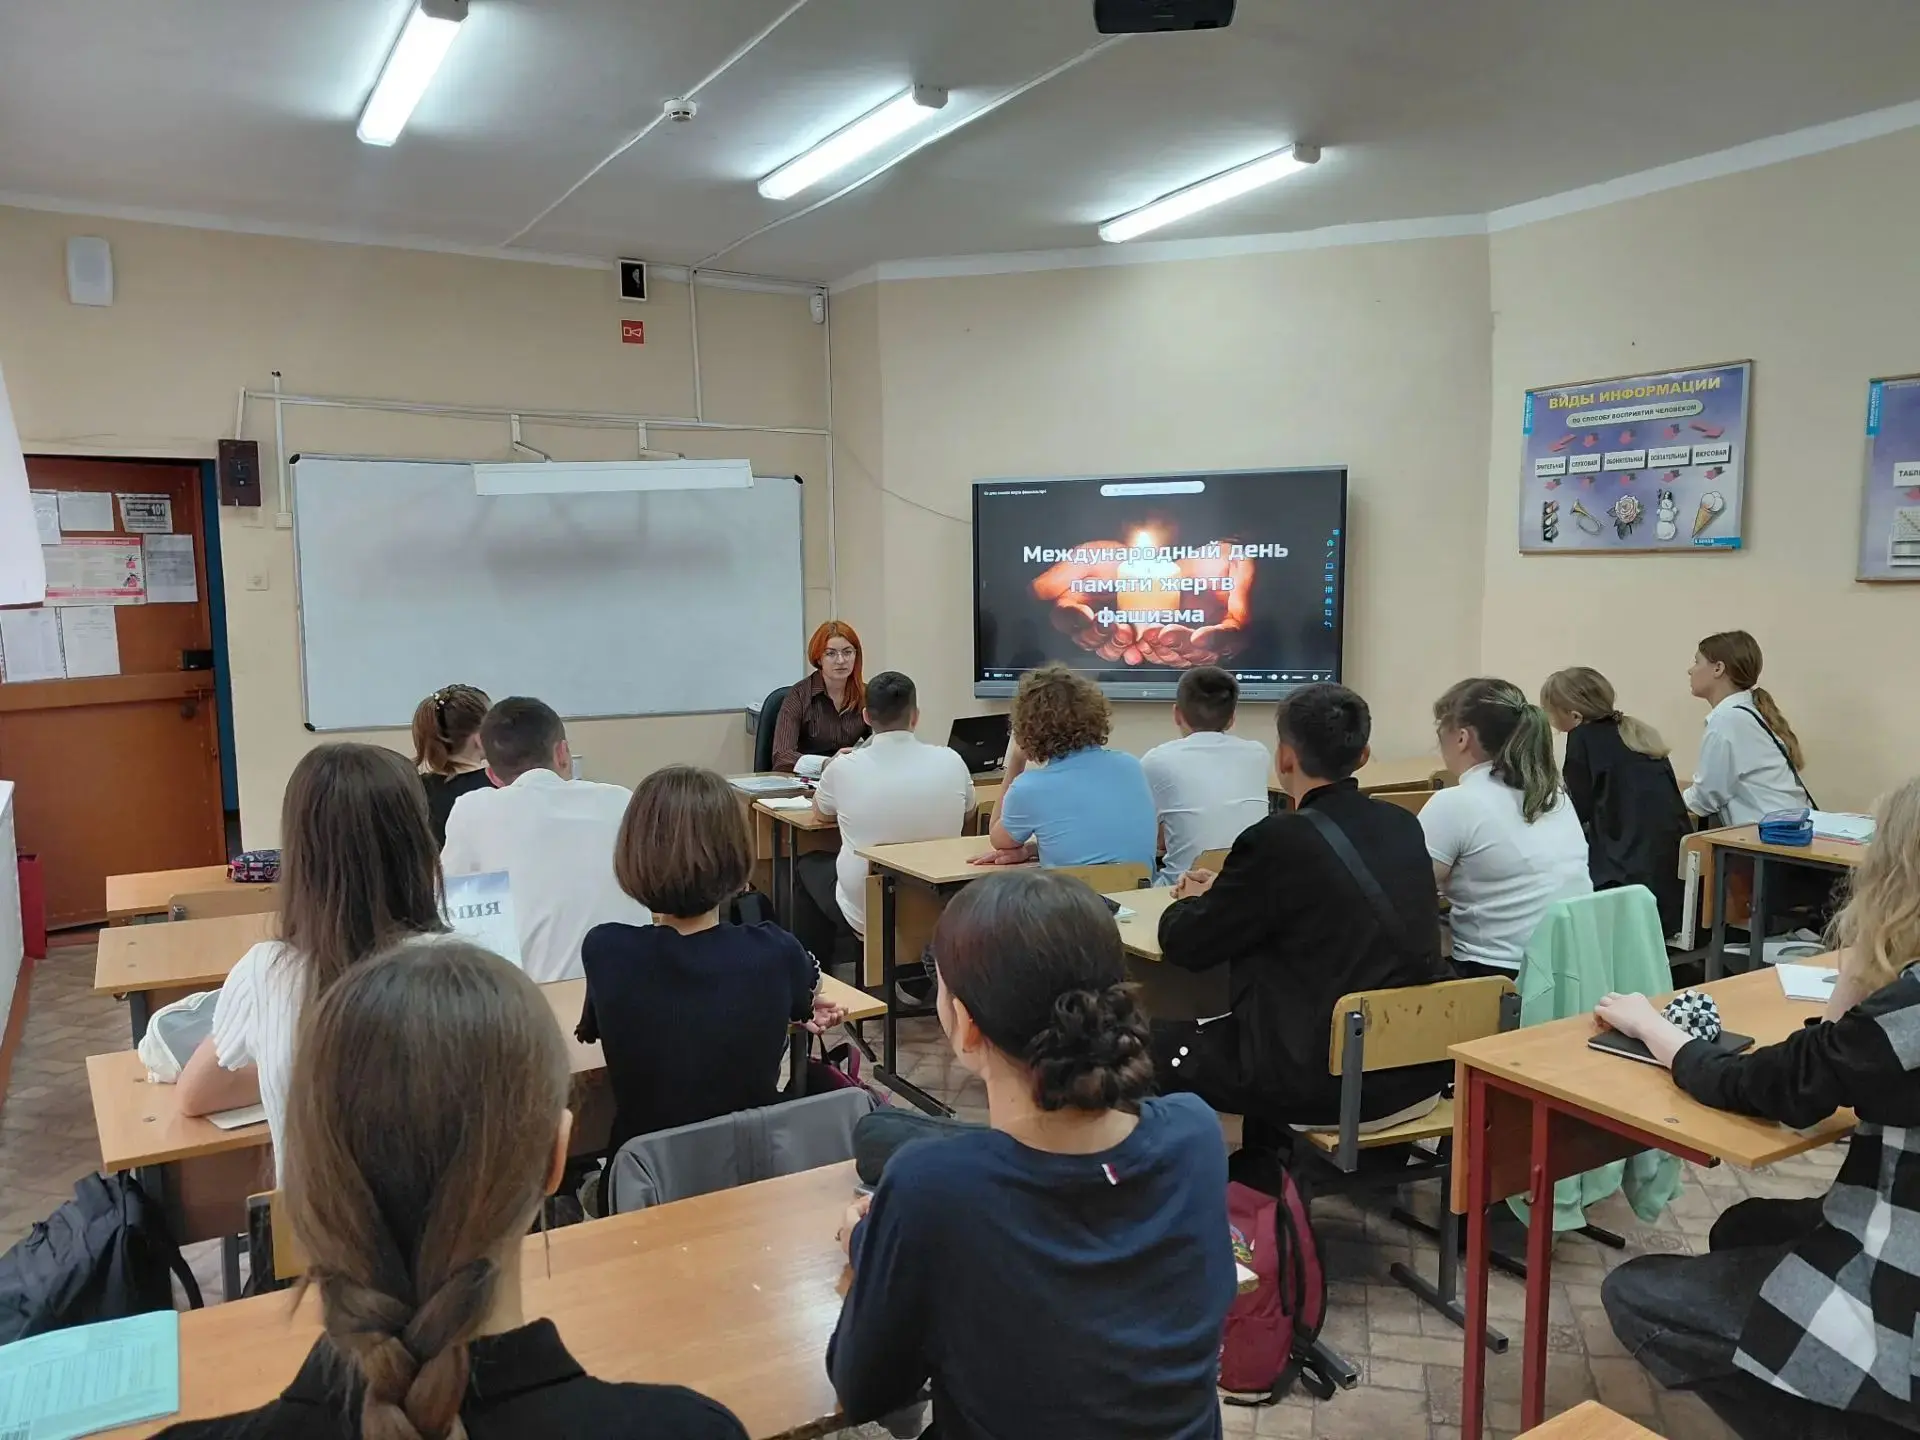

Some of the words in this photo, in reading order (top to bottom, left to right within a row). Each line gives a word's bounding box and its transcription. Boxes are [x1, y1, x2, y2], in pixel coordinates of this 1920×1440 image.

[1549, 393, 1594, 409] ВИДЫ
[1599, 377, 1721, 403] ИНФОРМАЦИИ
[1582, 415, 1610, 423] СПОСОБУ
[1611, 409, 1654, 420] ВОСПРИЯТИЯ
[1655, 404, 1697, 415] ЧЕЛОВЕКОМ
[1898, 469, 1920, 477] ТАБЛ
[152, 503, 165, 515] 101
[1023, 541, 1221, 566] Международный
[1228, 542, 1289, 560] день
[1070, 578, 1152, 594] памяти
[1159, 576, 1235, 596] жертв
[1097, 605, 1205, 628] фашизма
